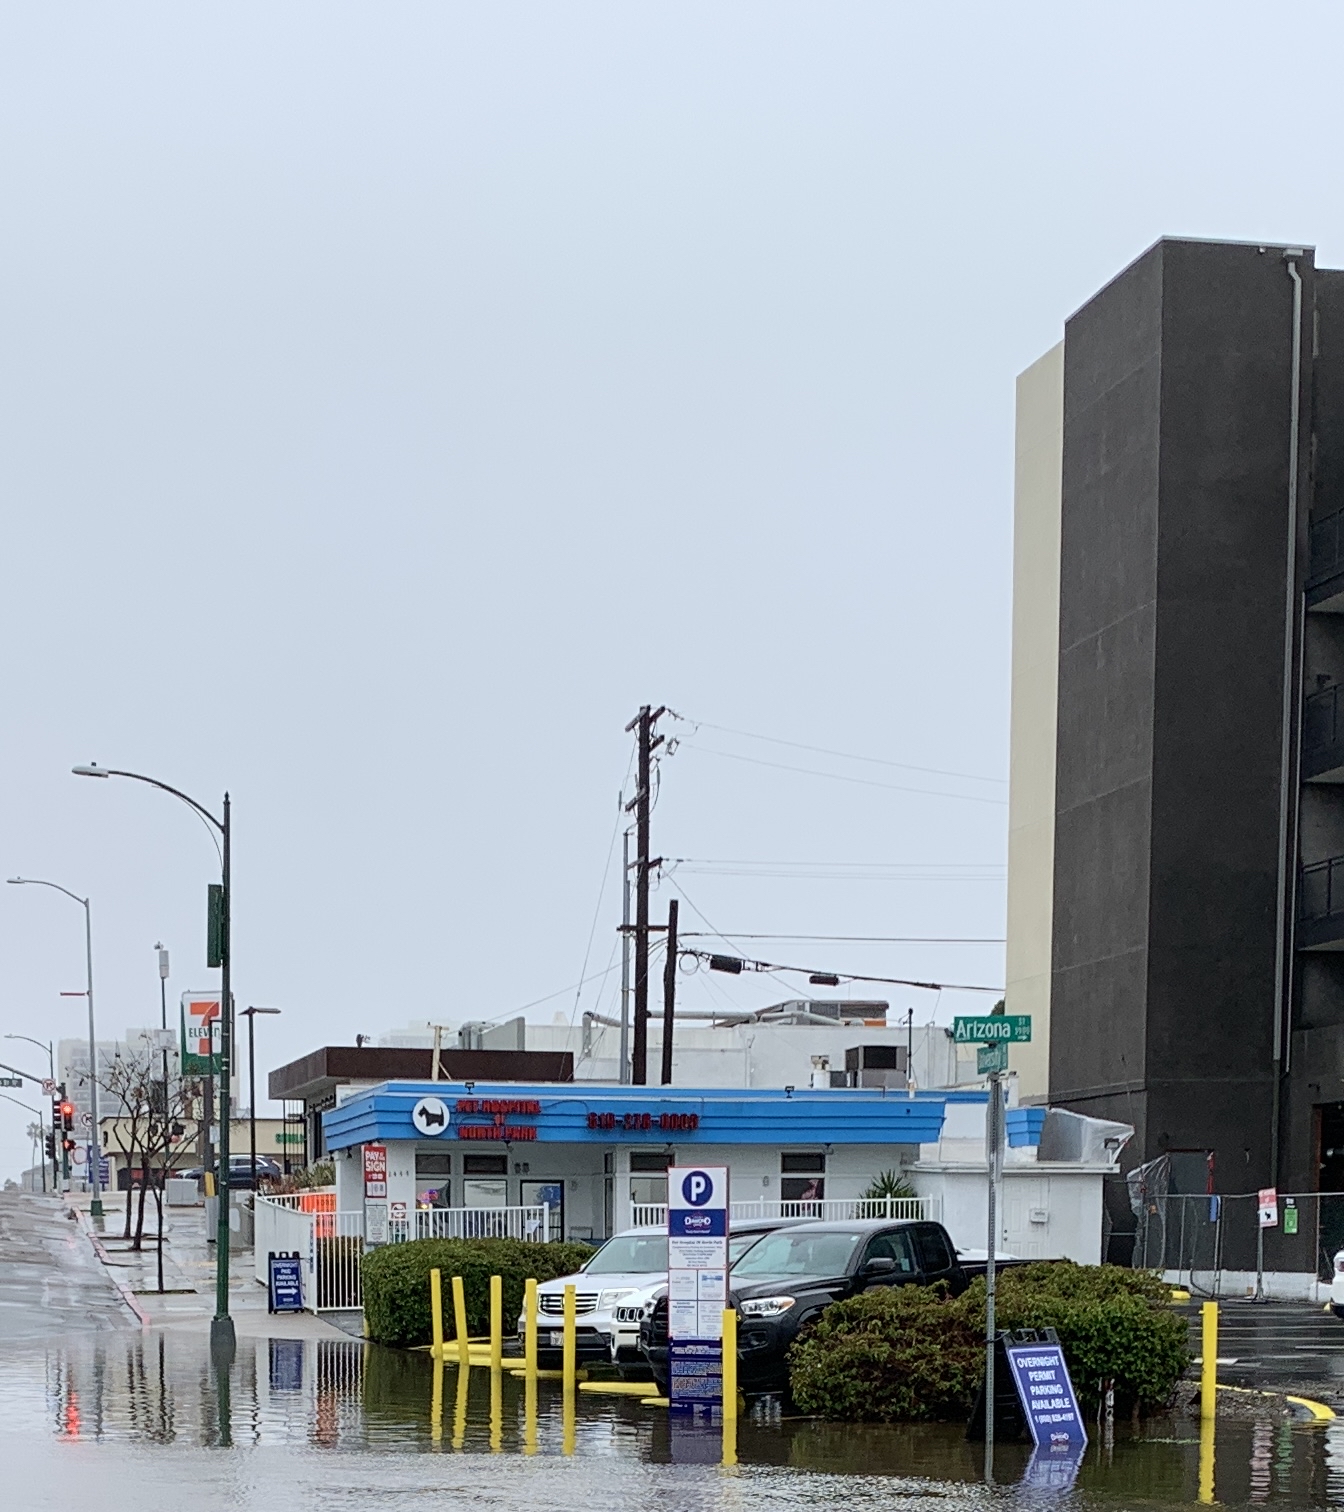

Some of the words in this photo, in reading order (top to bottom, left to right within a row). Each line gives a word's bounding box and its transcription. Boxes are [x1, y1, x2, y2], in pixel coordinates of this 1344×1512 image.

[189, 1027, 221, 1038] ELEVn
[956, 1019, 1011, 1038] Arizona
[365, 1151, 379, 1161] PAY
[365, 1161, 385, 1172] SIGN
[691, 1176, 706, 1202] P
[1017, 1356, 1059, 1368] OVERNIGHT
[1028, 1370, 1056, 1381] PERMIT
[1030, 1384, 1063, 1395] PARKING
[1031, 1398, 1072, 1410] AVAILABLE
